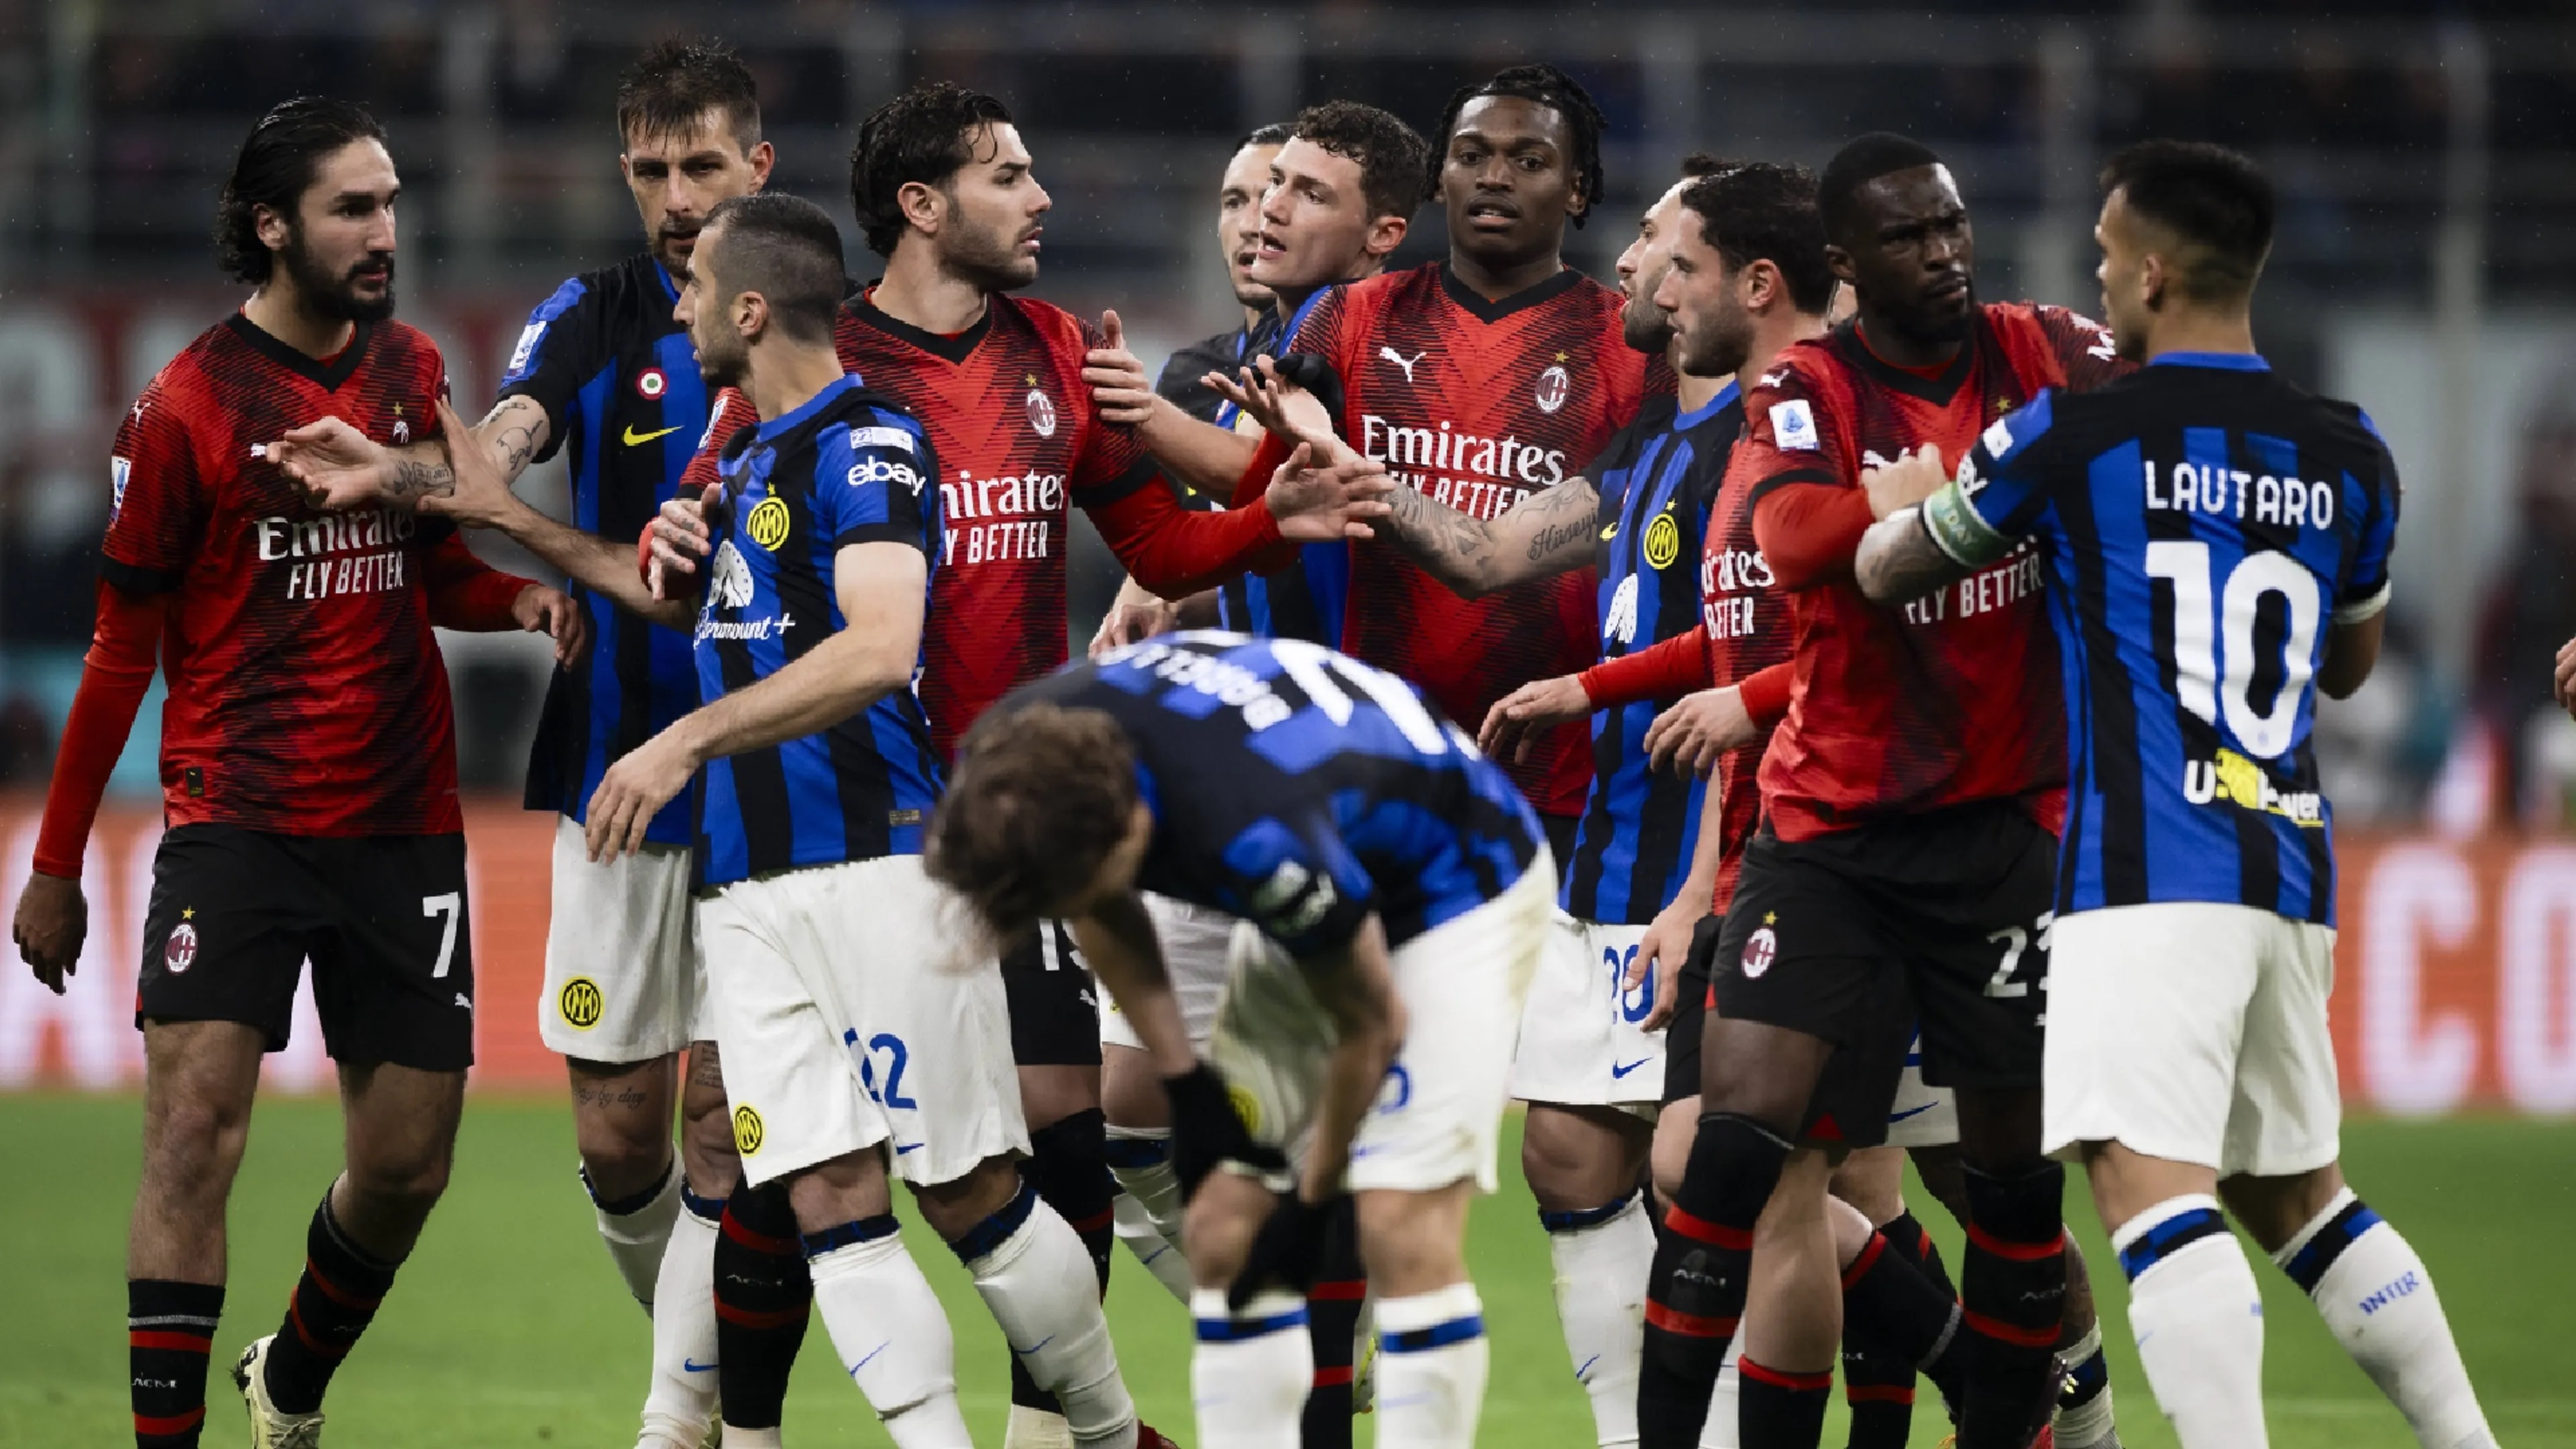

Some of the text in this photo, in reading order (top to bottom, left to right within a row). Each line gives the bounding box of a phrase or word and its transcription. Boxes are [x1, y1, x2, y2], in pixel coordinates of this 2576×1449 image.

[848, 455, 926, 496] ebay
[1362, 415, 1566, 486] Emirates
[940, 470, 1066, 519] irates
[2146, 460, 2333, 530] LAUTARO
[967, 521, 1048, 564] BETTER
[1701, 545, 1776, 597] irates
[287, 550, 404, 600] FLY BETTER
[1960, 551, 2044, 619] BETTER
[2145, 541, 2320, 759] 10
[423, 892, 460, 979] 7
